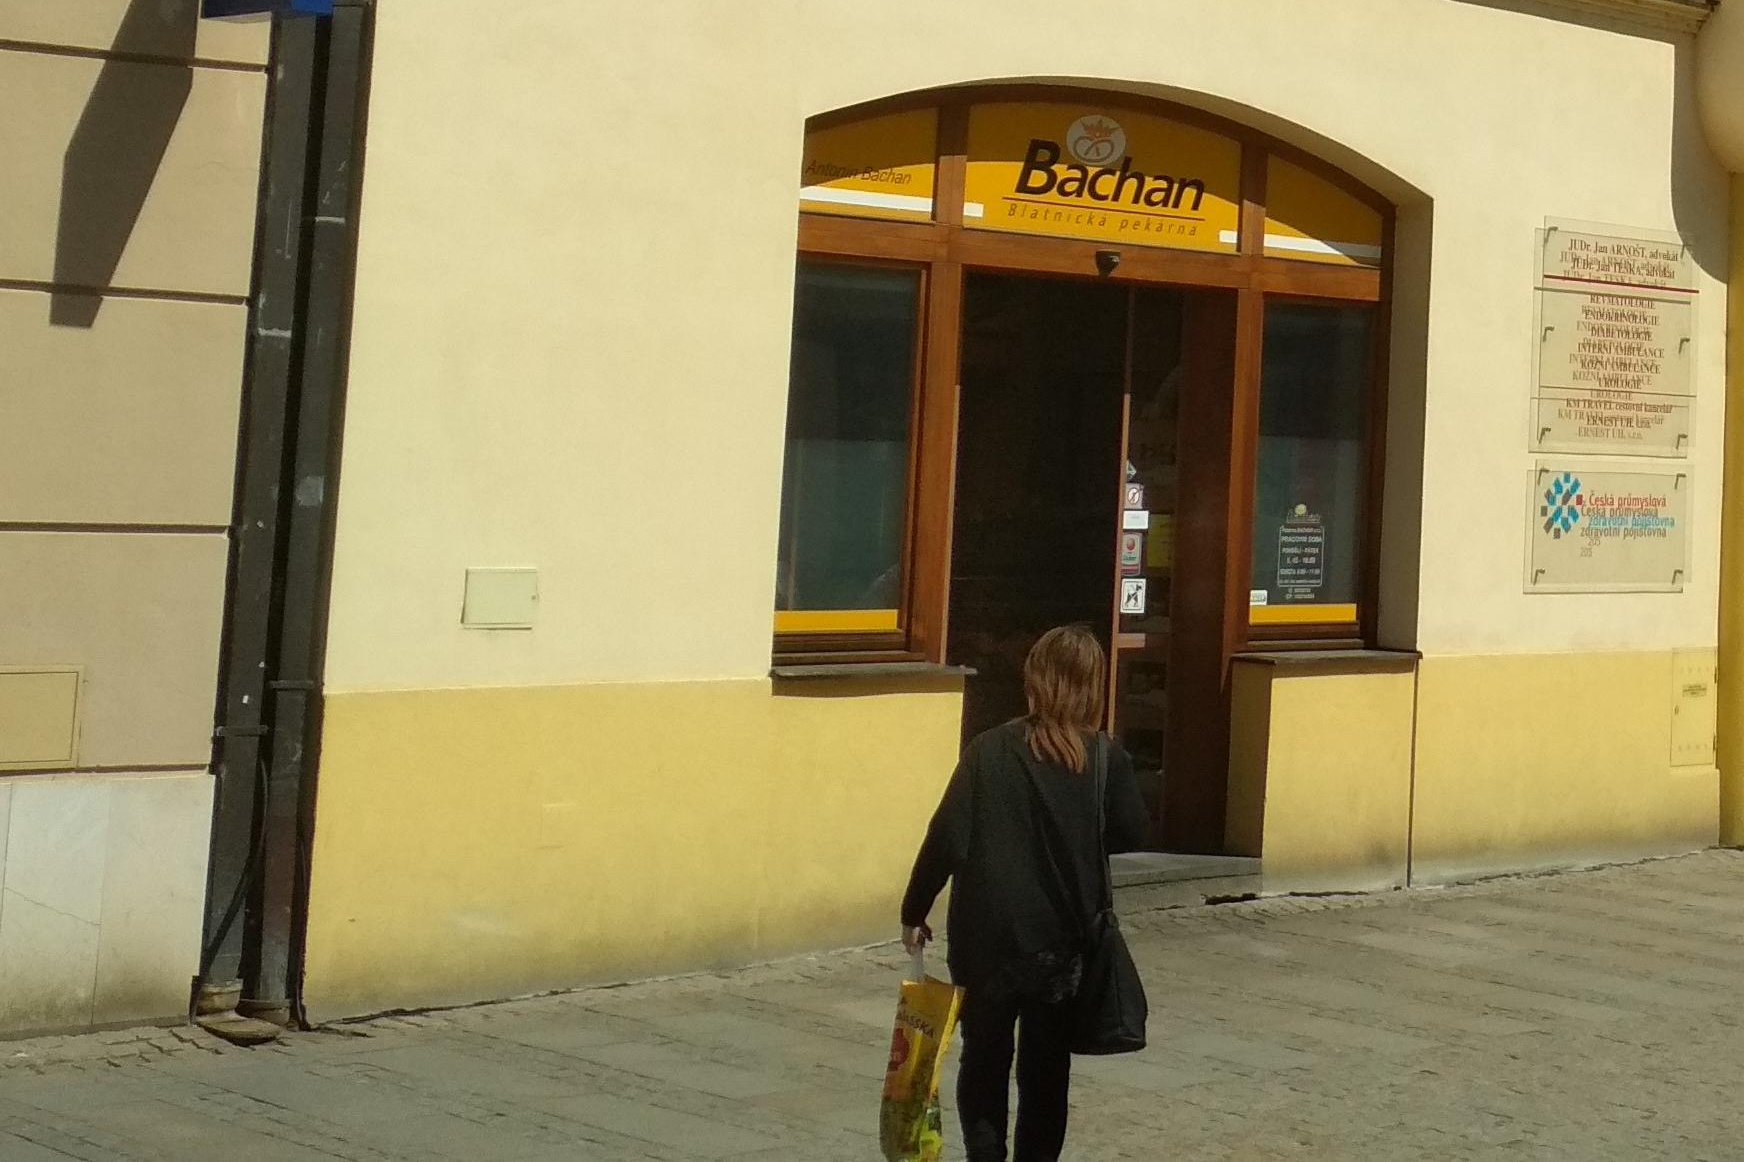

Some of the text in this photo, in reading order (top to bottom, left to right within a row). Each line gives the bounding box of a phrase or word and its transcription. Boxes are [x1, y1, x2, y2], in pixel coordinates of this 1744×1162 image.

[860, 165, 912, 185] Bachan
[1015, 138, 1205, 212] Bachan
[1008, 203, 1199, 237] Blatnická pekárna
[1568, 239, 1591, 252] JUDr.
[1594, 241, 1608, 254] Jan
[1649, 248, 1678, 262] advokát
[1571, 258, 1593, 271] JUDr.
[1596, 259, 1610, 272] Jan
[1590, 295, 1656, 309] REVMATOLOGIE
[1585, 309, 1659, 326] ENDOKRINOLOGIE
[1591, 326, 1652, 341] DIABETOLOGIE
[1613, 344, 1665, 359] AMBULANCE
[1612, 360, 1661, 375] AMBULANCE
[1599, 377, 1641, 390] UROLOGIE
[1566, 398, 1582, 409] KM
[1583, 399, 1615, 411] TRAVEL
[1589, 490, 1666, 511] Česká průmyslová
[1589, 516, 1628, 528] zdravotní
